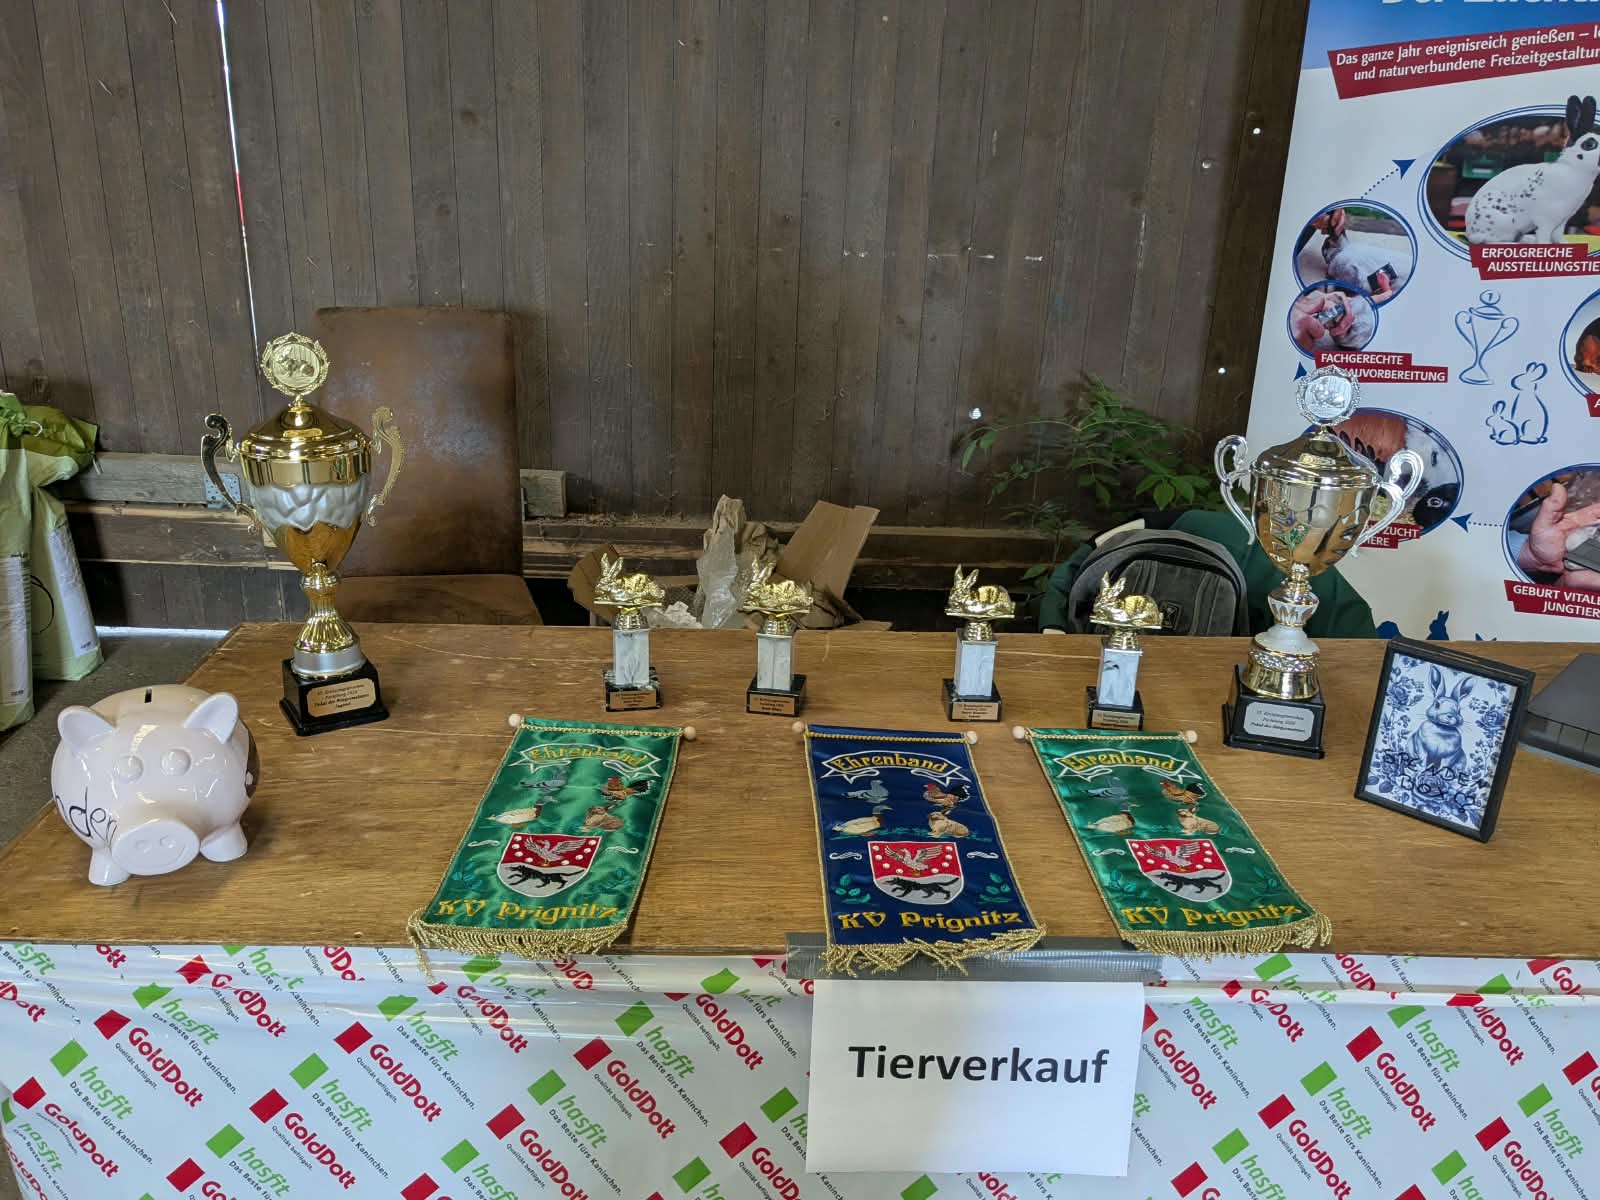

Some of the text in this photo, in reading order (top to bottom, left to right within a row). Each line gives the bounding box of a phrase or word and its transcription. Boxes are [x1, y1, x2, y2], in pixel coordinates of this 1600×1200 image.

[1336, 52, 1358, 67] Das
[1361, 50, 1394, 66] ganze
[1396, 45, 1422, 62] Jahr
[1425, 36, 1507, 56] ereignisreich
[1511, 29, 1575, 48] genießen
[1353, 67, 1376, 81] und
[1378, 58, 1486, 78] naturverbundene
[1481, 247, 1573, 259] ERFOLGREICHE
[1487, 260, 1600, 273] AUSSTELLUNGSTIE
[1320, 353, 1404, 365] FACHGERECHTE
[1342, 367, 1446, 382] AUVORBEREITUNG
[1513, 585, 1560, 599] GEBURT
[529, 746, 648, 767] Ehrenband
[831, 753, 949, 774] Ehrenband
[1060, 751, 1176, 771] Ehrenband
[436, 899, 620, 924] KV Prignitz
[837, 910, 1024, 933] KV Prignitz
[1120, 903, 1302, 926] KV Prignitz
[152, 1012, 167, 1025] Das
[169, 1022, 189, 1041] Beste
[188, 1038, 202, 1056] fürs
[161, 998, 220, 1045] hasfit
[406, 1010, 460, 1062] hasfit
[695, 993, 765, 1070] GoldDott
[1182, 1008, 1195, 1023] Das
[1194, 1022, 1211, 1045] Beste
[1210, 1043, 1224, 1061] fürs
[1415, 1019, 1460, 1072] hasfit
[1473, 1005, 1525, 1066] oldDott
[129, 1027, 204, 1107] GoldDott
[396, 1025, 410, 1040] Das
[409, 1037, 429, 1057] Beste
[428, 1054, 443, 1072] fürs
[636, 1040, 650, 1055] Das
[648, 1053, 667, 1074] Beste
[665, 1072, 679, 1089] fürs
[645, 1025, 695, 1079] hasfit
[848, 1045, 1109, 1084] Tierverkauf
[1153, 1028, 1217, 1110] GoldDott
[1406, 1032, 1418, 1048] Das
[1416, 1046, 1433, 1068] Beste
[1431, 1066, 1443, 1083] fürs
[70, 1080, 83, 1097] Das
[82, 1096, 102, 1117] Beste
[101, 1115, 117, 1132] fürs
[80, 1065, 134, 1120] hasfit
[320, 1078, 374, 1132] hasfit
[369, 1043, 442, 1122] GoldDott
[606, 1059, 676, 1140] GoldDott
[1376, 1052, 1437, 1132] GoldDott
[312, 1092, 325, 1107] Das
[324, 1105, 344, 1127] Beste
[342, 1125, 356, 1143] fürs
[549, 1109, 561, 1124] Das
[561, 1122, 578, 1143] Beste
[577, 1142, 592, 1159] fürs
[557, 1095, 608, 1149] hasfit
[781, 1126, 793, 1141] Das
[1319, 1099, 1330, 1115] Das
[1329, 1112, 1345, 1135] Beste
[1343, 1133, 1356, 1150] fürs
[1327, 1086, 1373, 1140] hasfit
[1543, 1108, 1584, 1160] hasfit
[17, 1122, 63, 1173] hasfit
[44, 1103, 120, 1178] GoldDott
[284, 1112, 356, 1190] GoldDott
[1533, 1120, 1544, 1135] Das
[1542, 1133, 1556, 1155] Beste
[1554, 1152, 1567, 1170] fürs
[229, 1160, 243, 1174] Das
[242, 1172, 262, 1191] Beste
[238, 1147, 290, 1197] hasfit
[463, 1176, 476, 1190] Das
[752, 1147, 800, 1200] GoldD
[1232, 1167, 1243, 1183] Das
[1504, 1140, 1555, 1200] GoldDo
